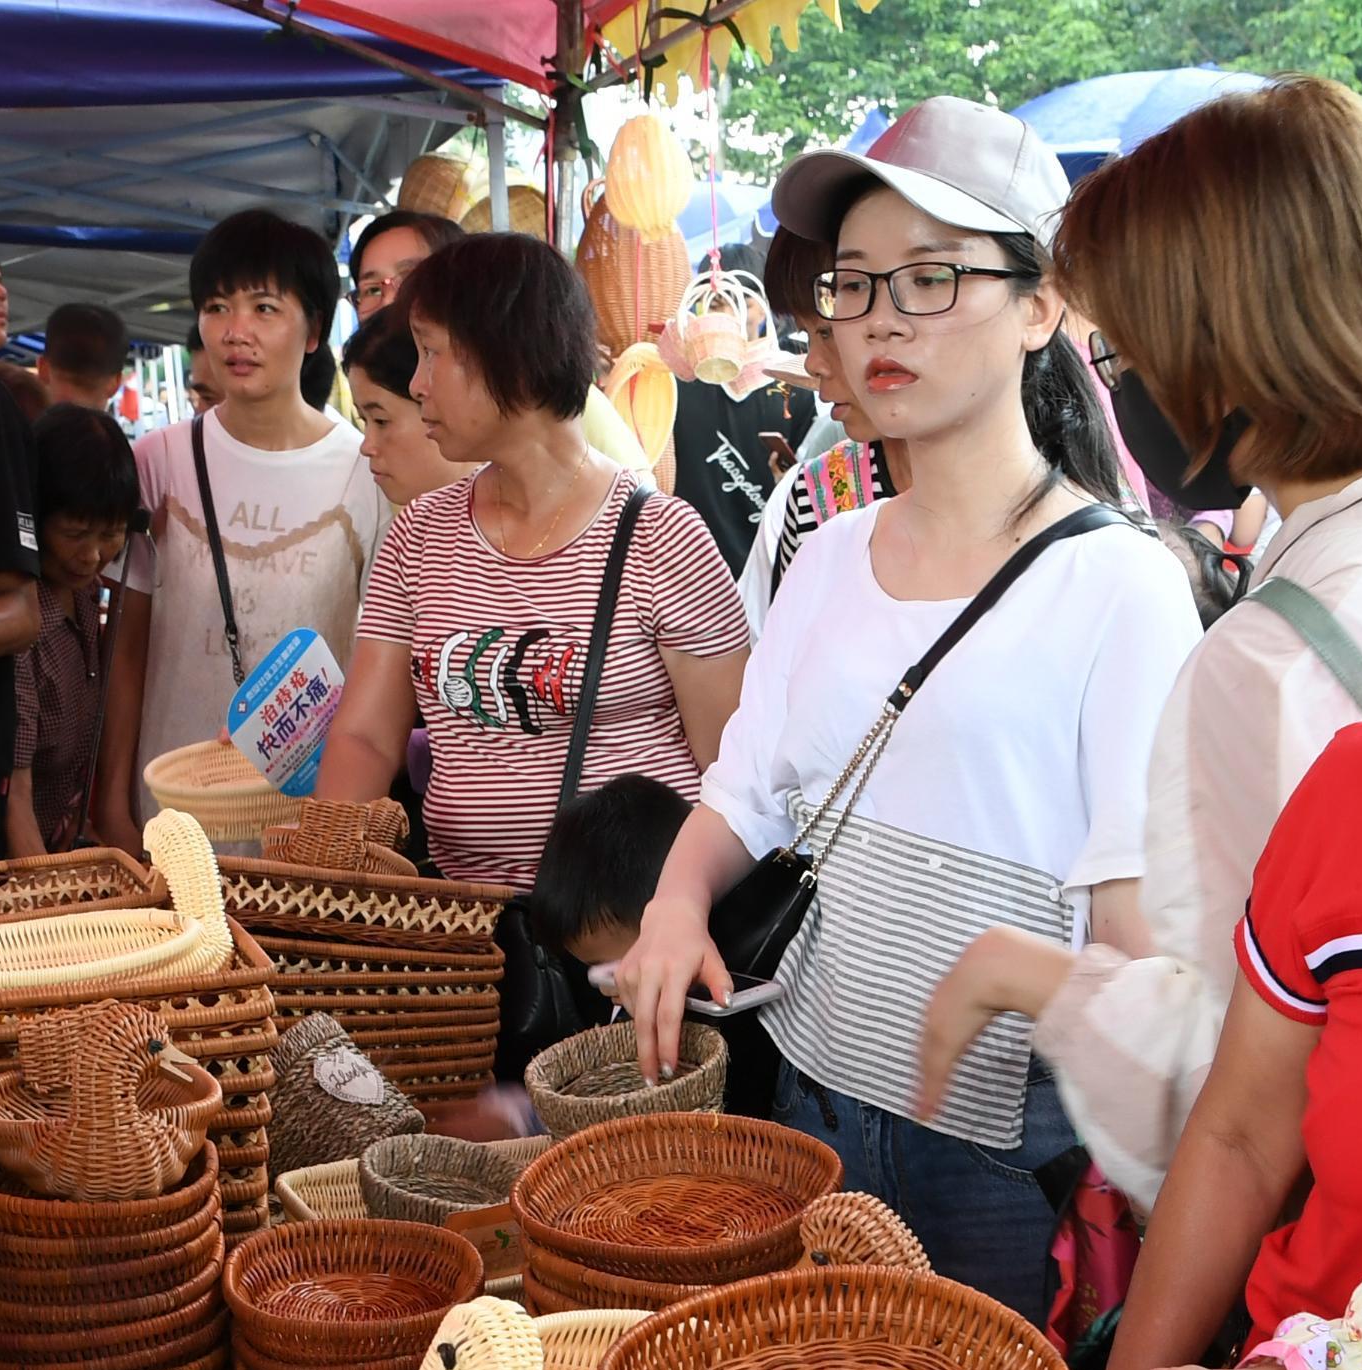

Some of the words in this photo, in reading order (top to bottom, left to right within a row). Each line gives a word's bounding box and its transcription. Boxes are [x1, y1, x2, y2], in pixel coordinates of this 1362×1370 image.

[228, 501, 286, 532] ALL
[259, 667, 309, 726] 治痔疮
